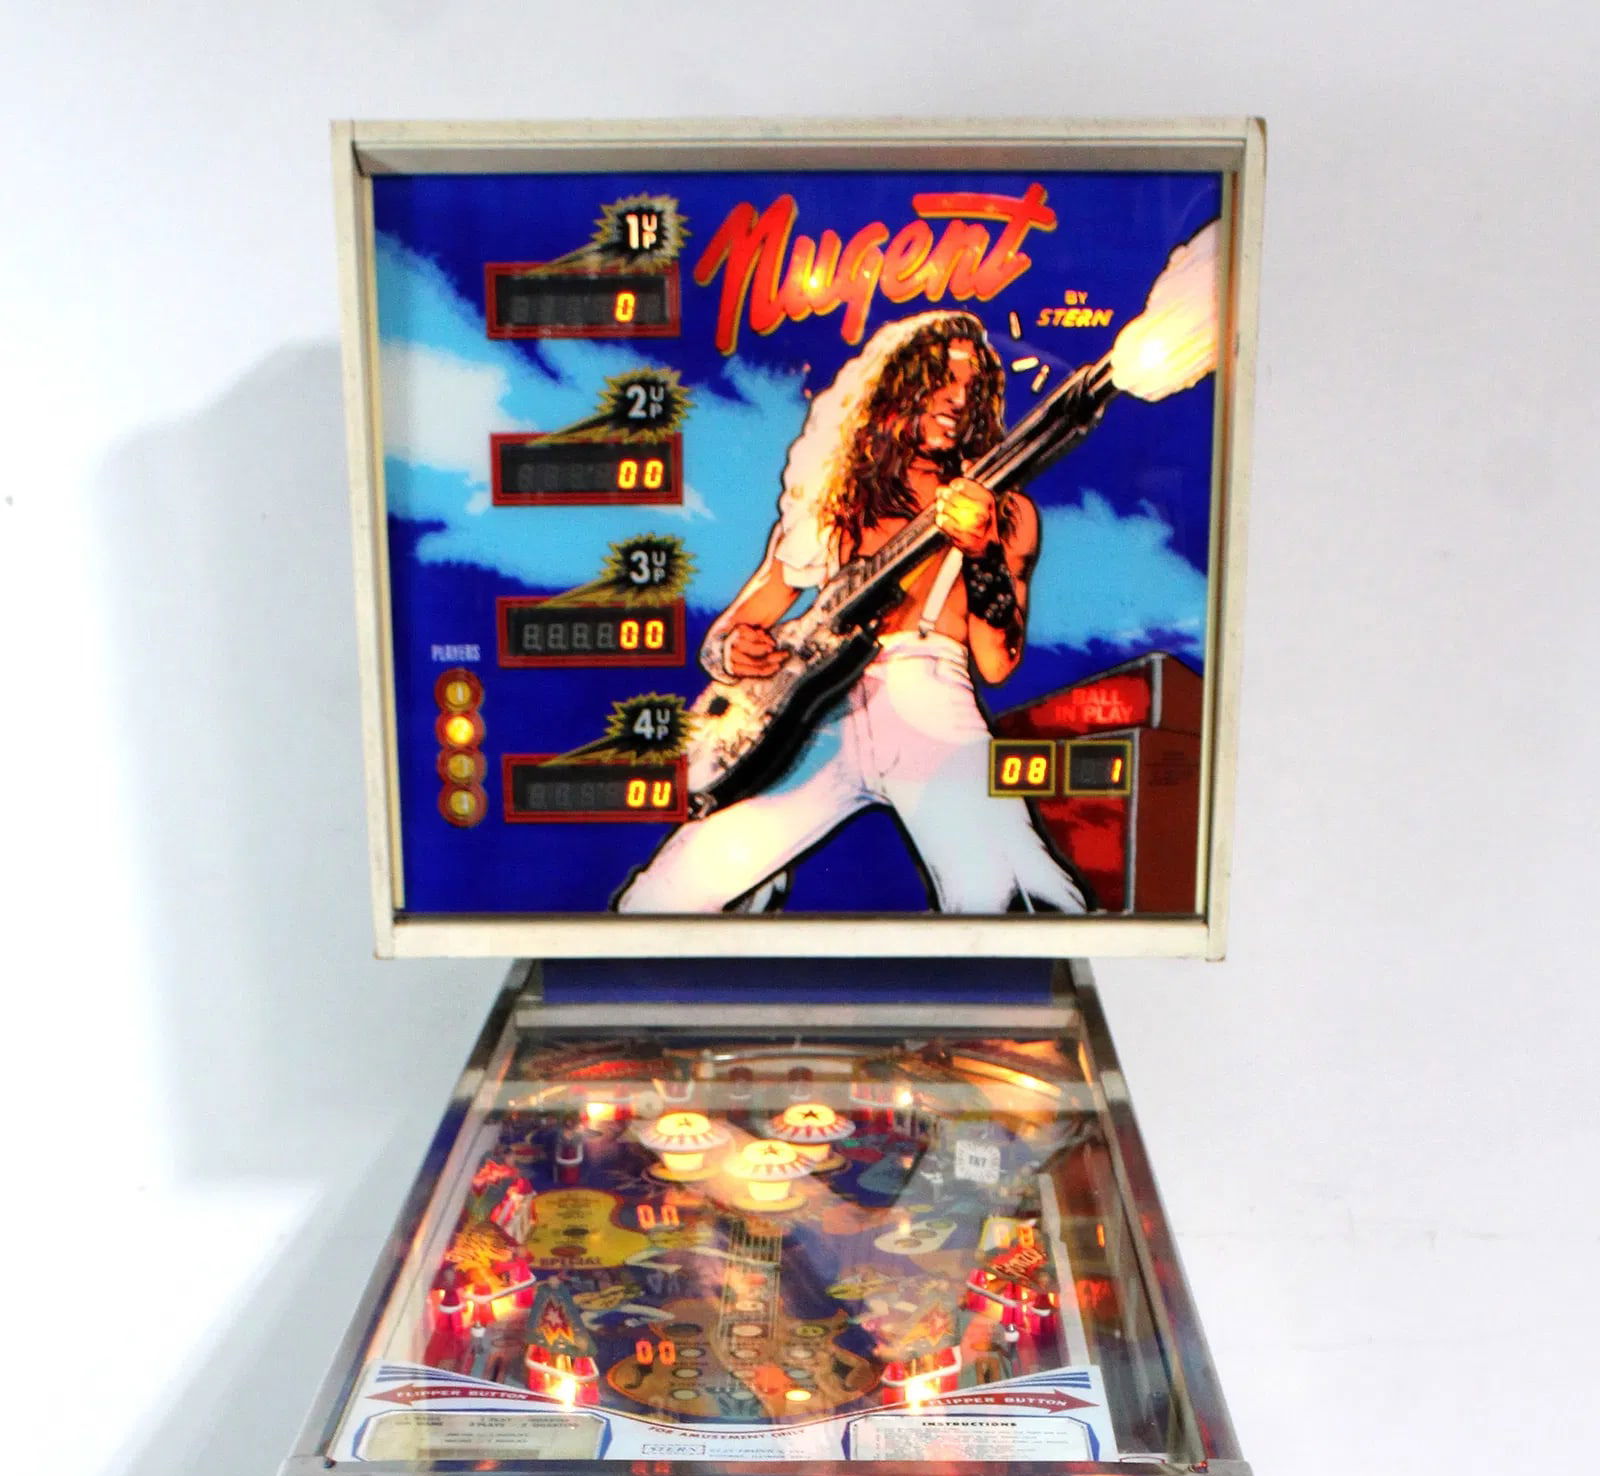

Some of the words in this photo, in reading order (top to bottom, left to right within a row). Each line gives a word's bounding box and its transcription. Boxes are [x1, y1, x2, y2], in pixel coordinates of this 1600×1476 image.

[694, 183, 1058, 356] Nugent
[614, 291, 636, 323] 0
[1064, 289, 1088, 306] BY
[1036, 308, 1114, 328] STERN
[618, 459, 664, 490] 00
[1072, 688, 1121, 704] BALL
[1055, 705, 1075, 720] IN
[1083, 706, 1134, 723] PLAY
[1002, 756, 1048, 785] 08
[1111, 757, 1123, 784] 1
[396, 1389, 462, 1398] FLIPPER
[468, 1390, 529, 1400] BUTTON
[929, 1397, 995, 1407] FLIPPER
[1004, 1396, 1068, 1407] BUTTON
[648, 1426, 673, 1435] FOR
[681, 1431, 769, 1441] AMUSEMENT
